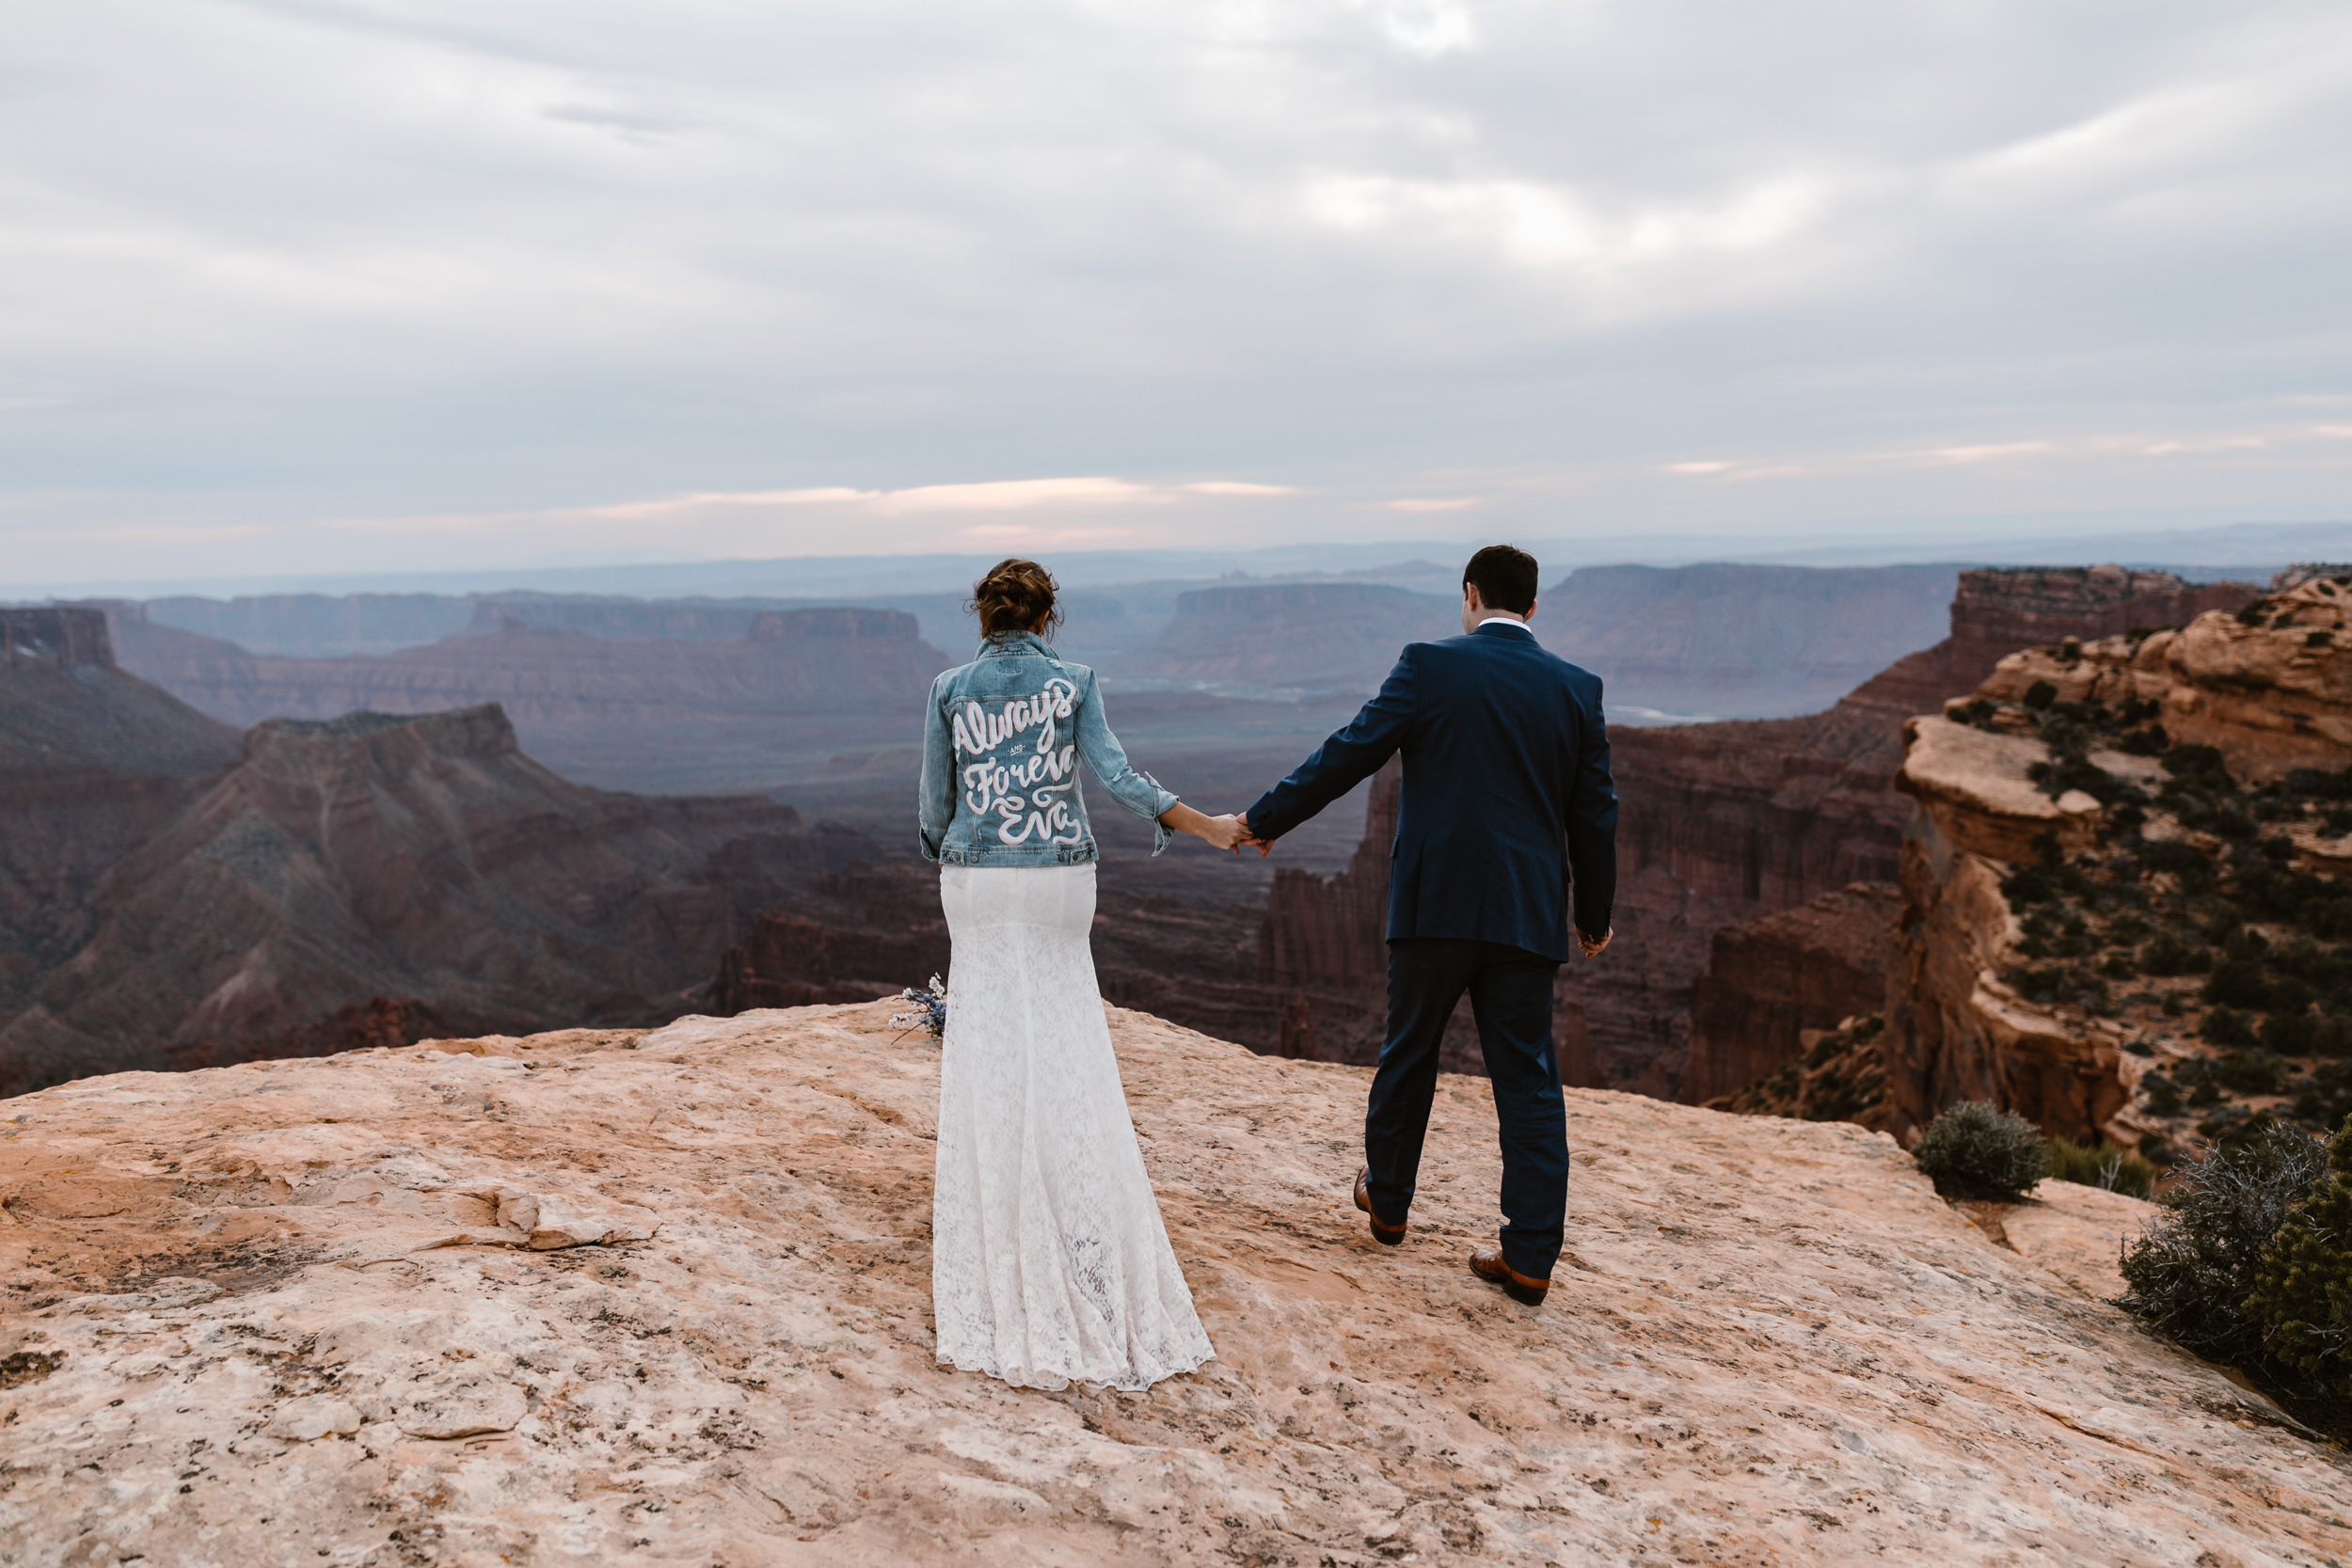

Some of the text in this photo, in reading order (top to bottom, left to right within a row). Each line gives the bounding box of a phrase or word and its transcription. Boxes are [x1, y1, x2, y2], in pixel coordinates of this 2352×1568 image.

[952, 677, 1076, 756] Always
[1009, 744, 1024, 753] AND
[991, 796, 1082, 846] Eva
